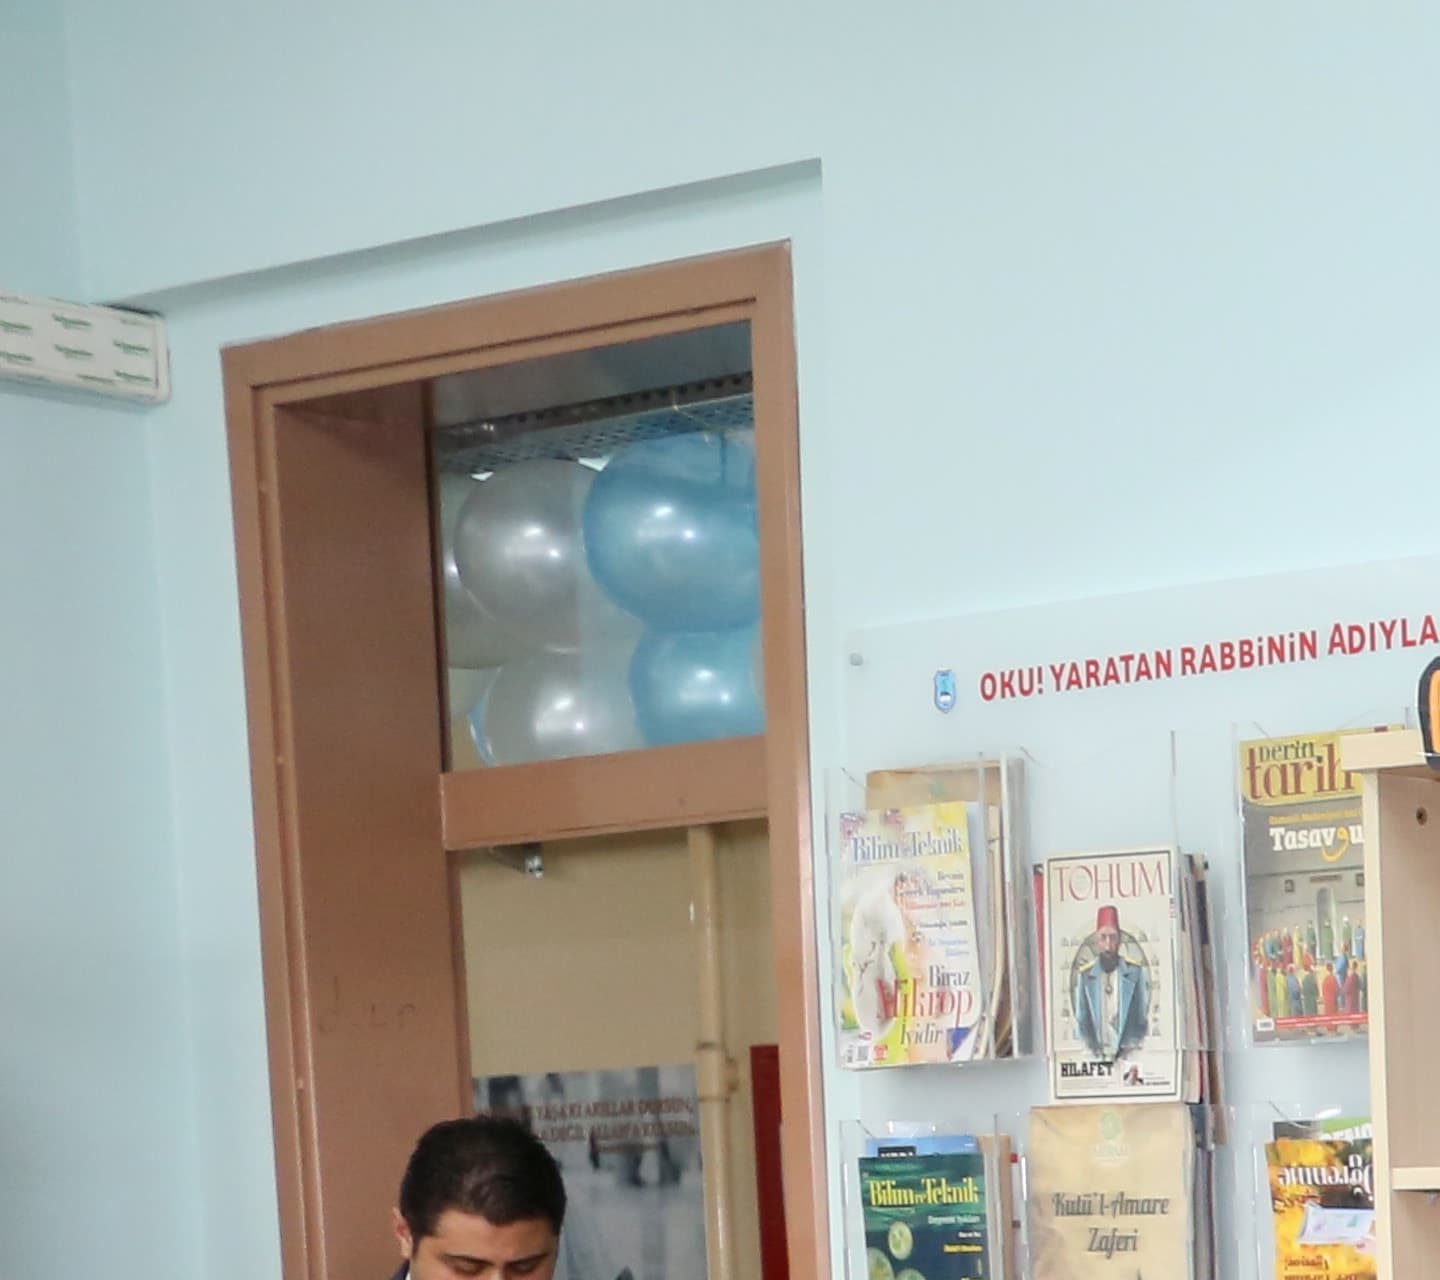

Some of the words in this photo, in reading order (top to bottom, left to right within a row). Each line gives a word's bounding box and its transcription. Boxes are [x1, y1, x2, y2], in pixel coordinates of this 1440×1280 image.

[980, 666, 1044, 701] OKU!
[1049, 648, 1172, 692] YARATAN
[1327, 614, 1439, 655] ADIYLA
[1054, 861, 1165, 902] TOHUM
[869, 1180, 914, 1207] Bilim
[921, 1176, 979, 1204] Teknik
[1088, 1228, 1138, 1259] Zaferi
